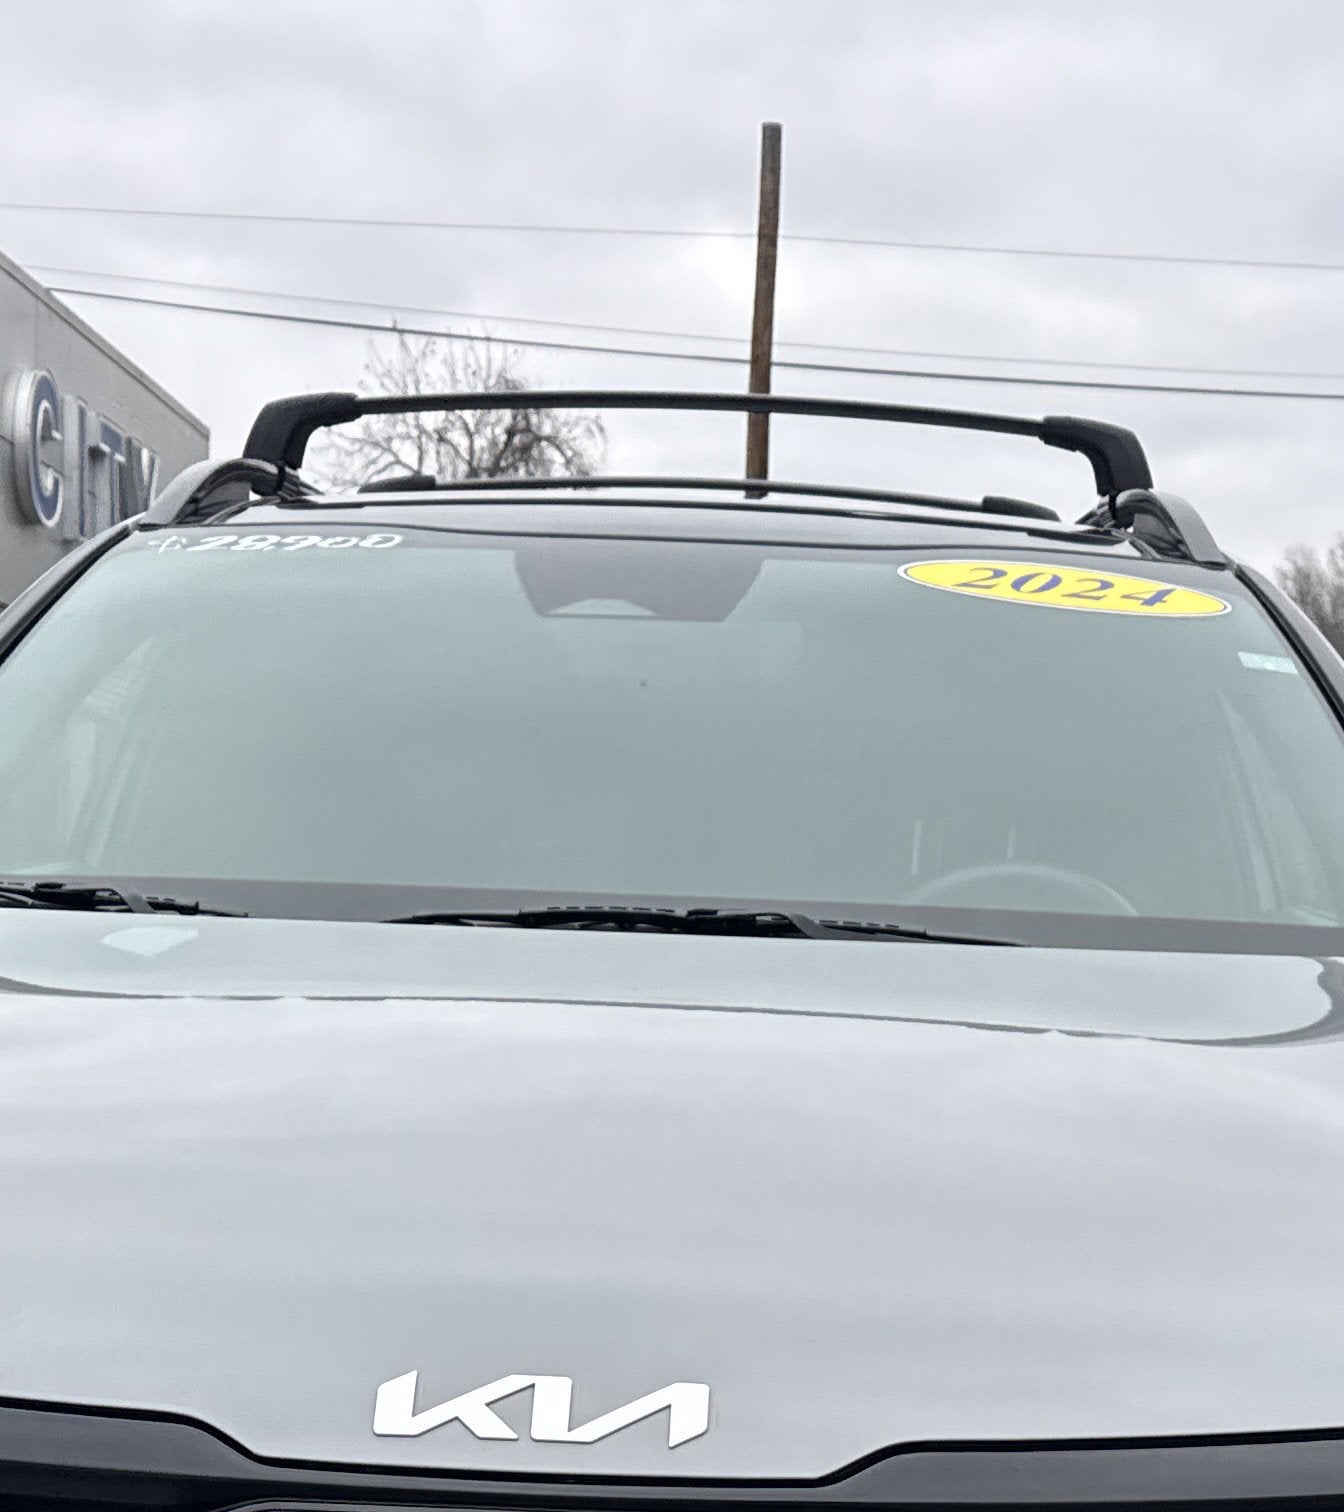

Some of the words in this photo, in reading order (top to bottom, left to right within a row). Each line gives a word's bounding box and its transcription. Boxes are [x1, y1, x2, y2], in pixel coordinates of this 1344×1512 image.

[10, 366, 160, 541] CITY
[950, 566, 1179, 608] 2024
[372, 1369, 711, 1450] KIA
